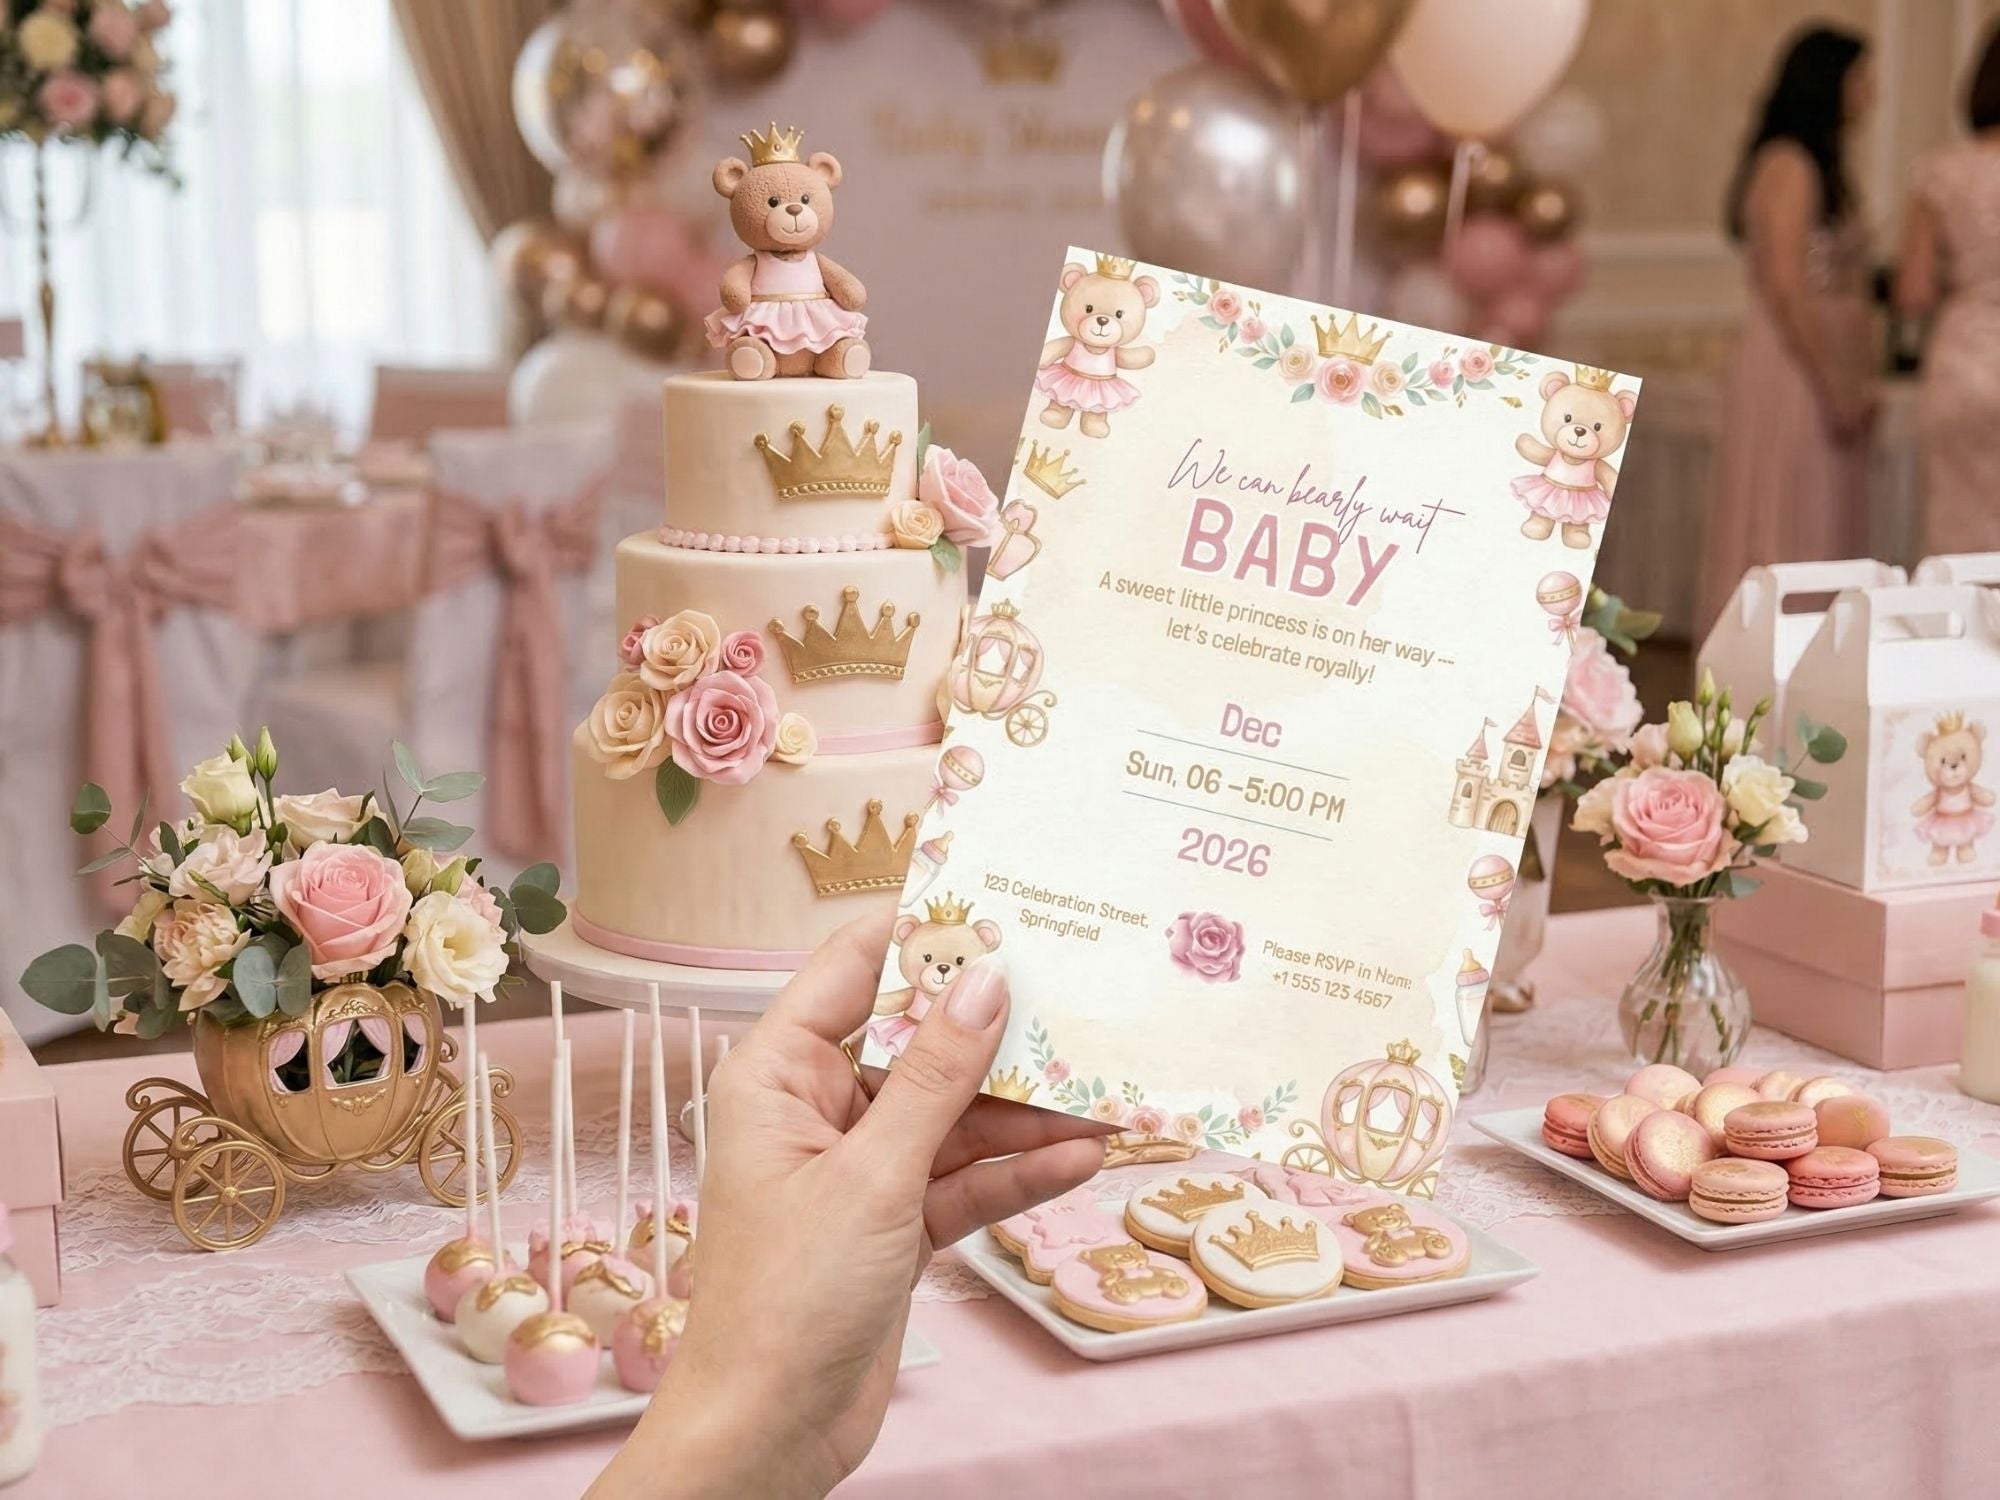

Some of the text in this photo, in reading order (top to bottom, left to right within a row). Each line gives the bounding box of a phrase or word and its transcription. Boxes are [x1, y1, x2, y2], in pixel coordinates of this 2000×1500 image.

[1167, 438, 1466, 554] We can bearly wait
[1180, 497, 1401, 607] BABY
[1099, 570, 1112, 591] A
[1115, 575, 1176, 605] sweet
[1180, 587, 1224, 617] little
[1226, 600, 1308, 636] princess
[1312, 618, 1328, 640] is
[1332, 626, 1356, 647] on
[1359, 630, 1393, 657] her
[1166, 617, 1377, 686] let's celebrate royally!
[1219, 703, 1282, 748] Dec
[1125, 750, 1177, 788] Sun,
[1186, 764, 1223, 794] 06
[1308, 792, 1346, 823] PM
[1177, 827, 1272, 877] 2026
[983, 873, 1009, 893] 123
[1011, 881, 1095, 915] Celebration
[1019, 908, 1101, 942] Springfield
[1262, 939, 1311, 965] Please
[1314, 952, 1355, 974] RSVP
[1357, 963, 1372, 980] in
[1291, 973, 1321, 993] 555
[1324, 980, 1351, 1000] 123
[1353, 988, 1393, 1010] 4567
